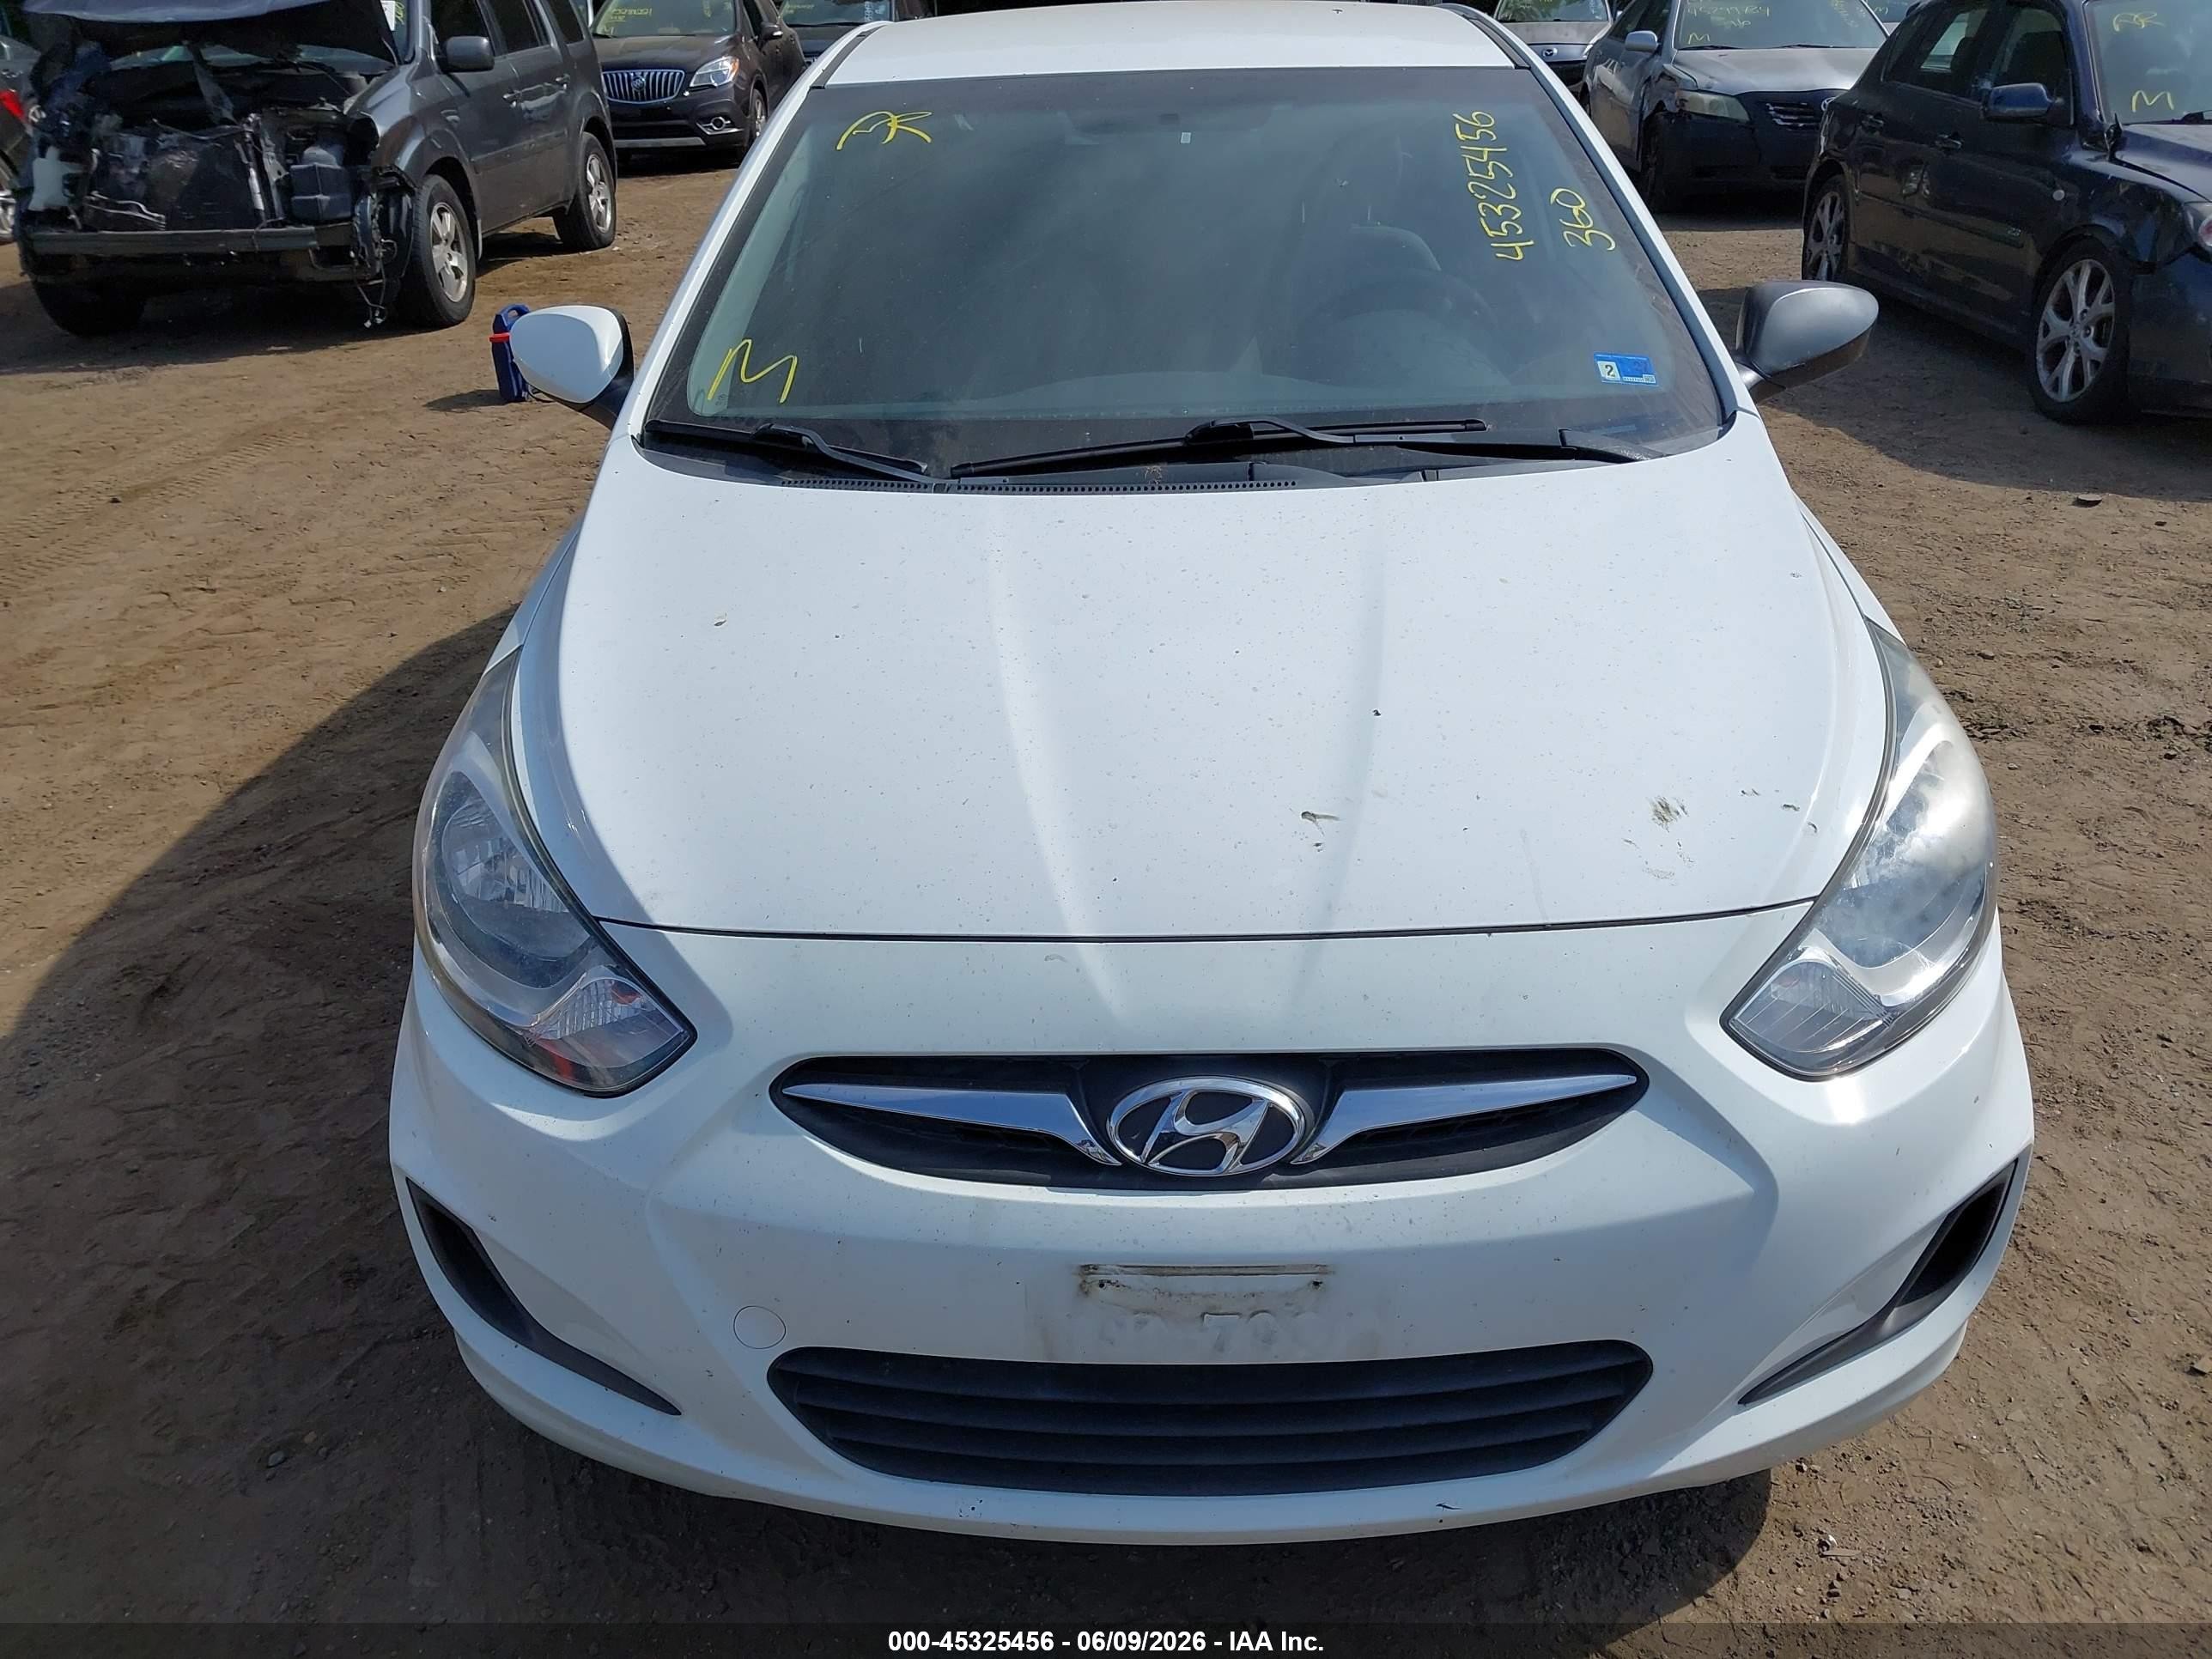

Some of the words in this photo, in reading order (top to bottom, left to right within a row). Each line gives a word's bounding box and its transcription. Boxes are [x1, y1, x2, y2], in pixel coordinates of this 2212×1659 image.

[1688, 33, 1711, 45] M
[2131, 89, 2174, 113] M
[1452, 111, 1534, 261] 45325456
[1550, 187, 1616, 252] 360
[707, 338, 798, 404] M
[1604, 364, 1616, 378] 2
